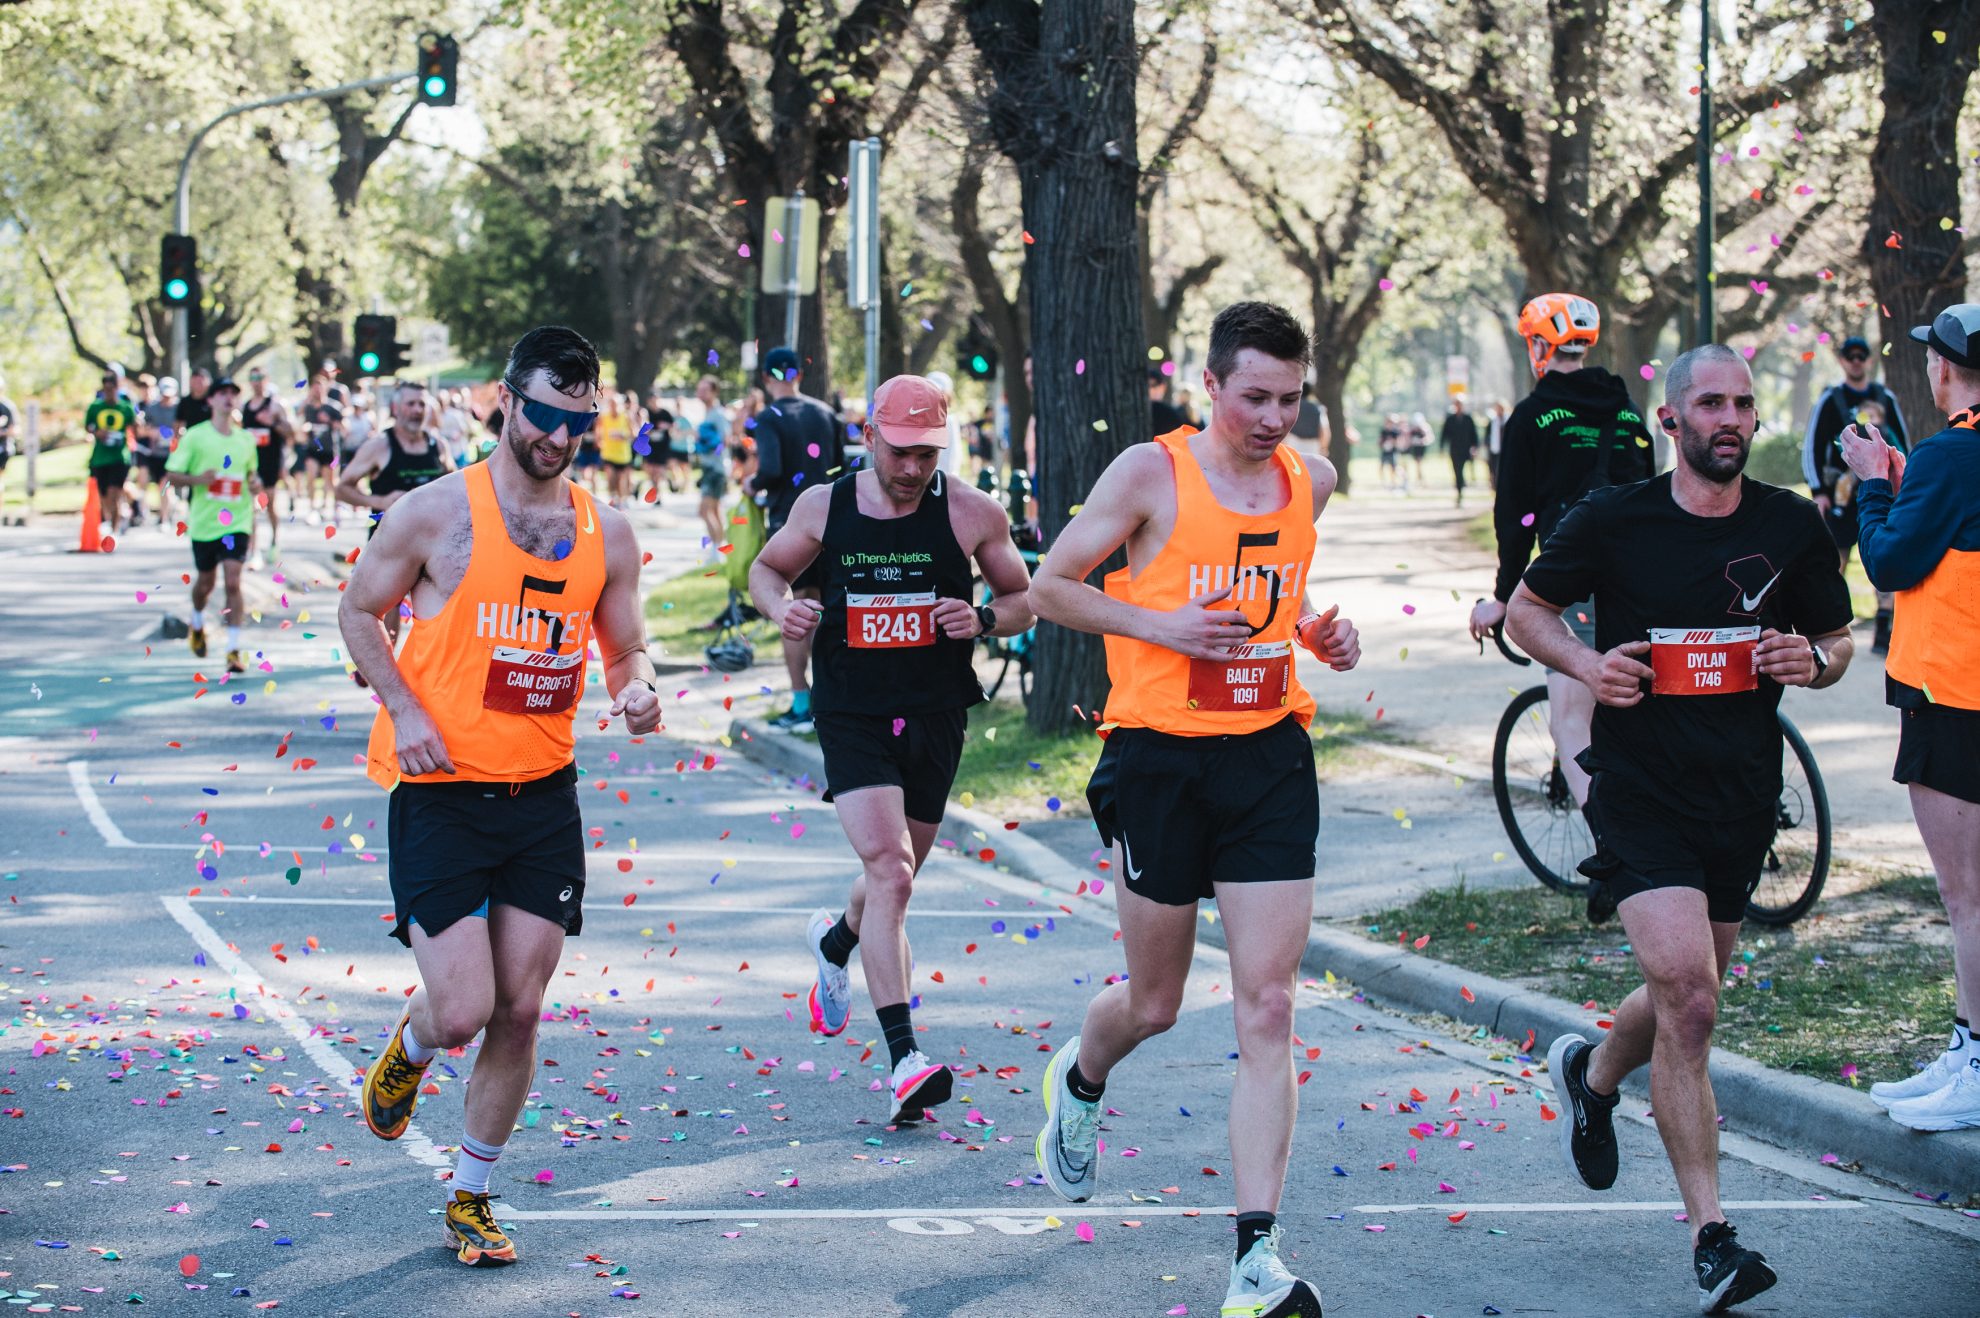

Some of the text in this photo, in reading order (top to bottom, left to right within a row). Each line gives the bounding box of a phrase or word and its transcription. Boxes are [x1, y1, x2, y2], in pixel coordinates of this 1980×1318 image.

[841, 554, 855, 567] Up
[856, 553, 887, 564] There
[862, 612, 921, 643] 5243
[1687, 652, 1727, 669] DYLAN
[507, 671, 573, 690] CAM CROFTS
[1226, 667, 1266, 684] BAILEY
[1694, 671, 1722, 688] 1746
[526, 693, 552, 708] 1944
[1232, 687, 1259, 704] 1091
